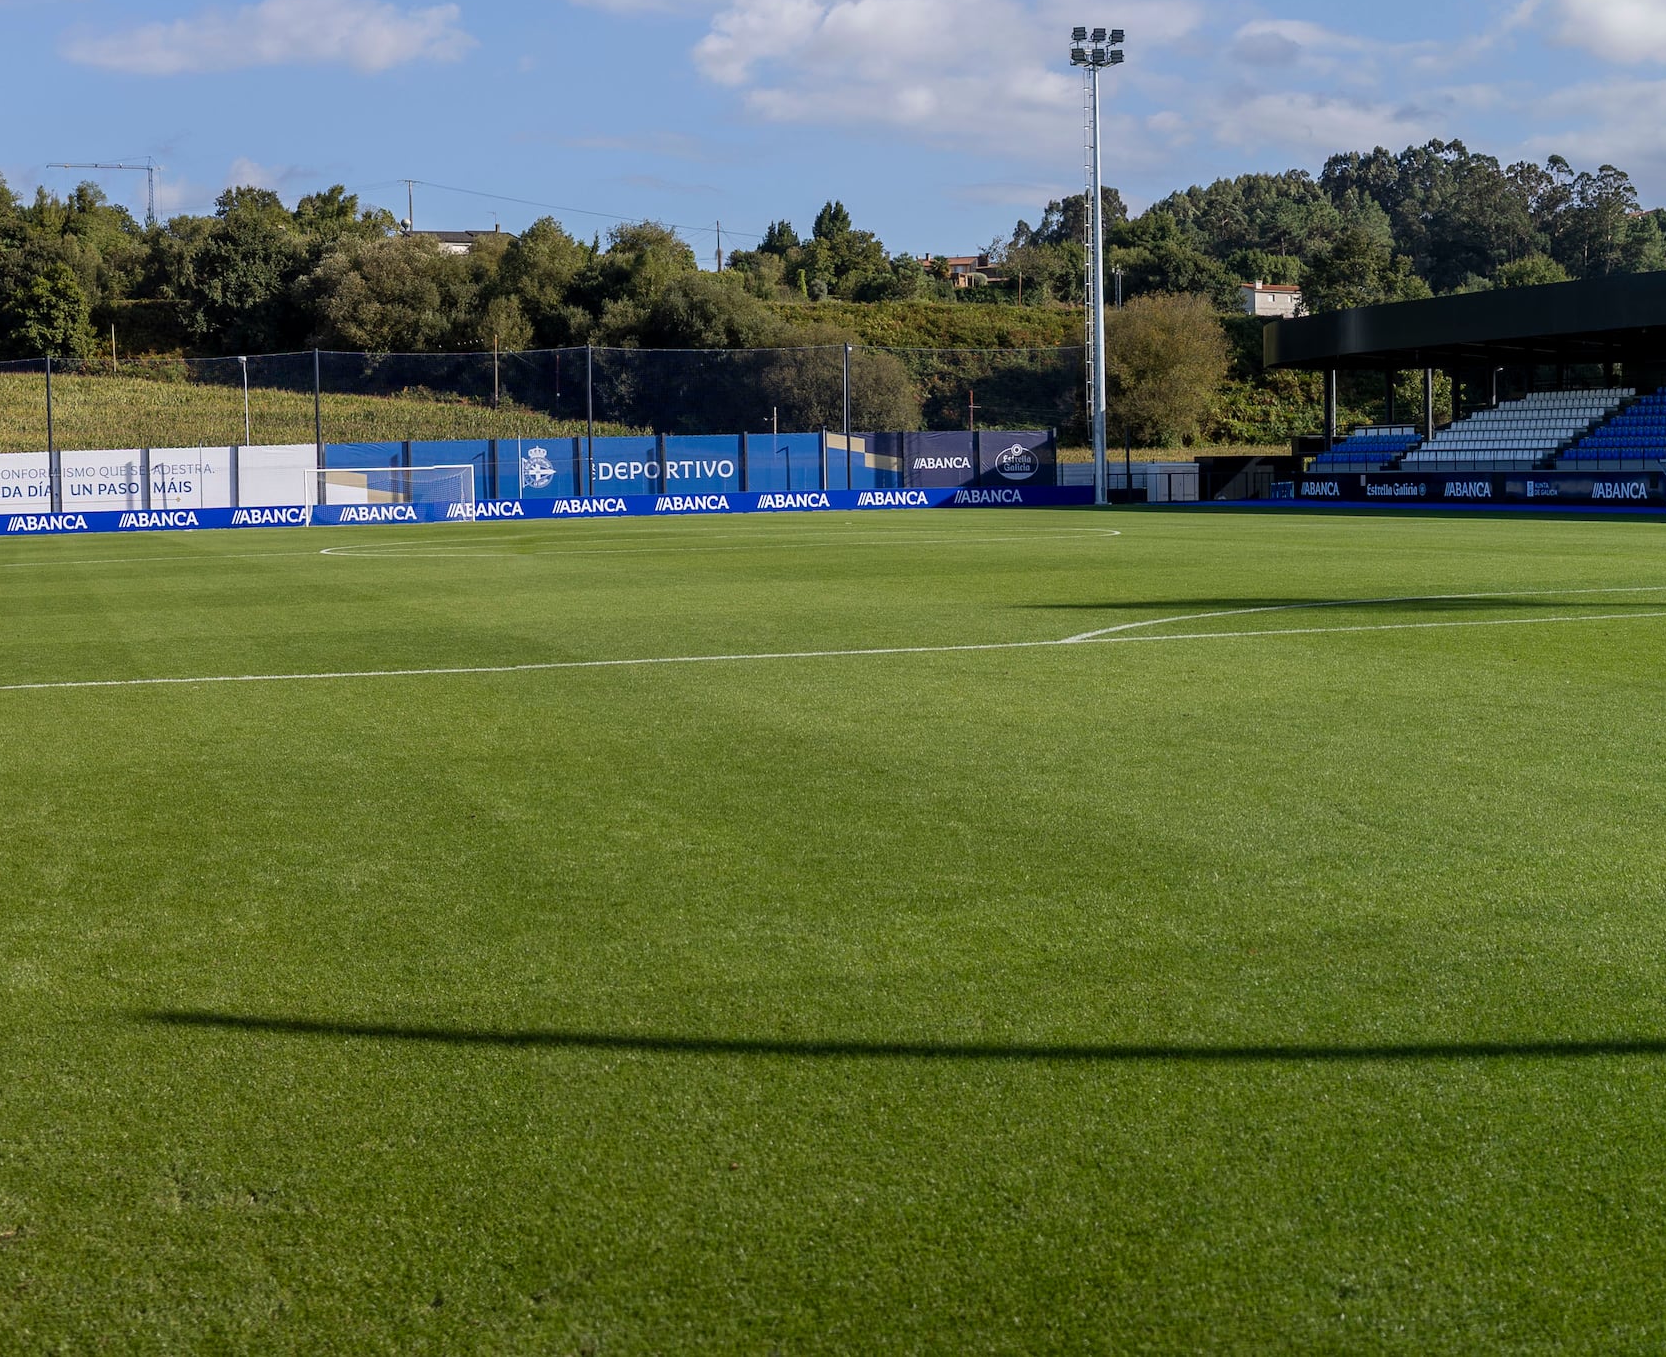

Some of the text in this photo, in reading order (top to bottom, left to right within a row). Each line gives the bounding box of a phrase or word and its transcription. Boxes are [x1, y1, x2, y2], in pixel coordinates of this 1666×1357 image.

[1002, 454, 1031, 463] Estrella
[99, 466, 126, 478] QUE
[598, 460, 734, 480] DEPORTIVO
[1004, 463, 1030, 472] Galicia
[71, 483, 93, 496] UN
[98, 482, 139, 495] PASO
[153, 477, 192, 493] MÁIS
[1366, 482, 1417, 496] Estrella Galicia
